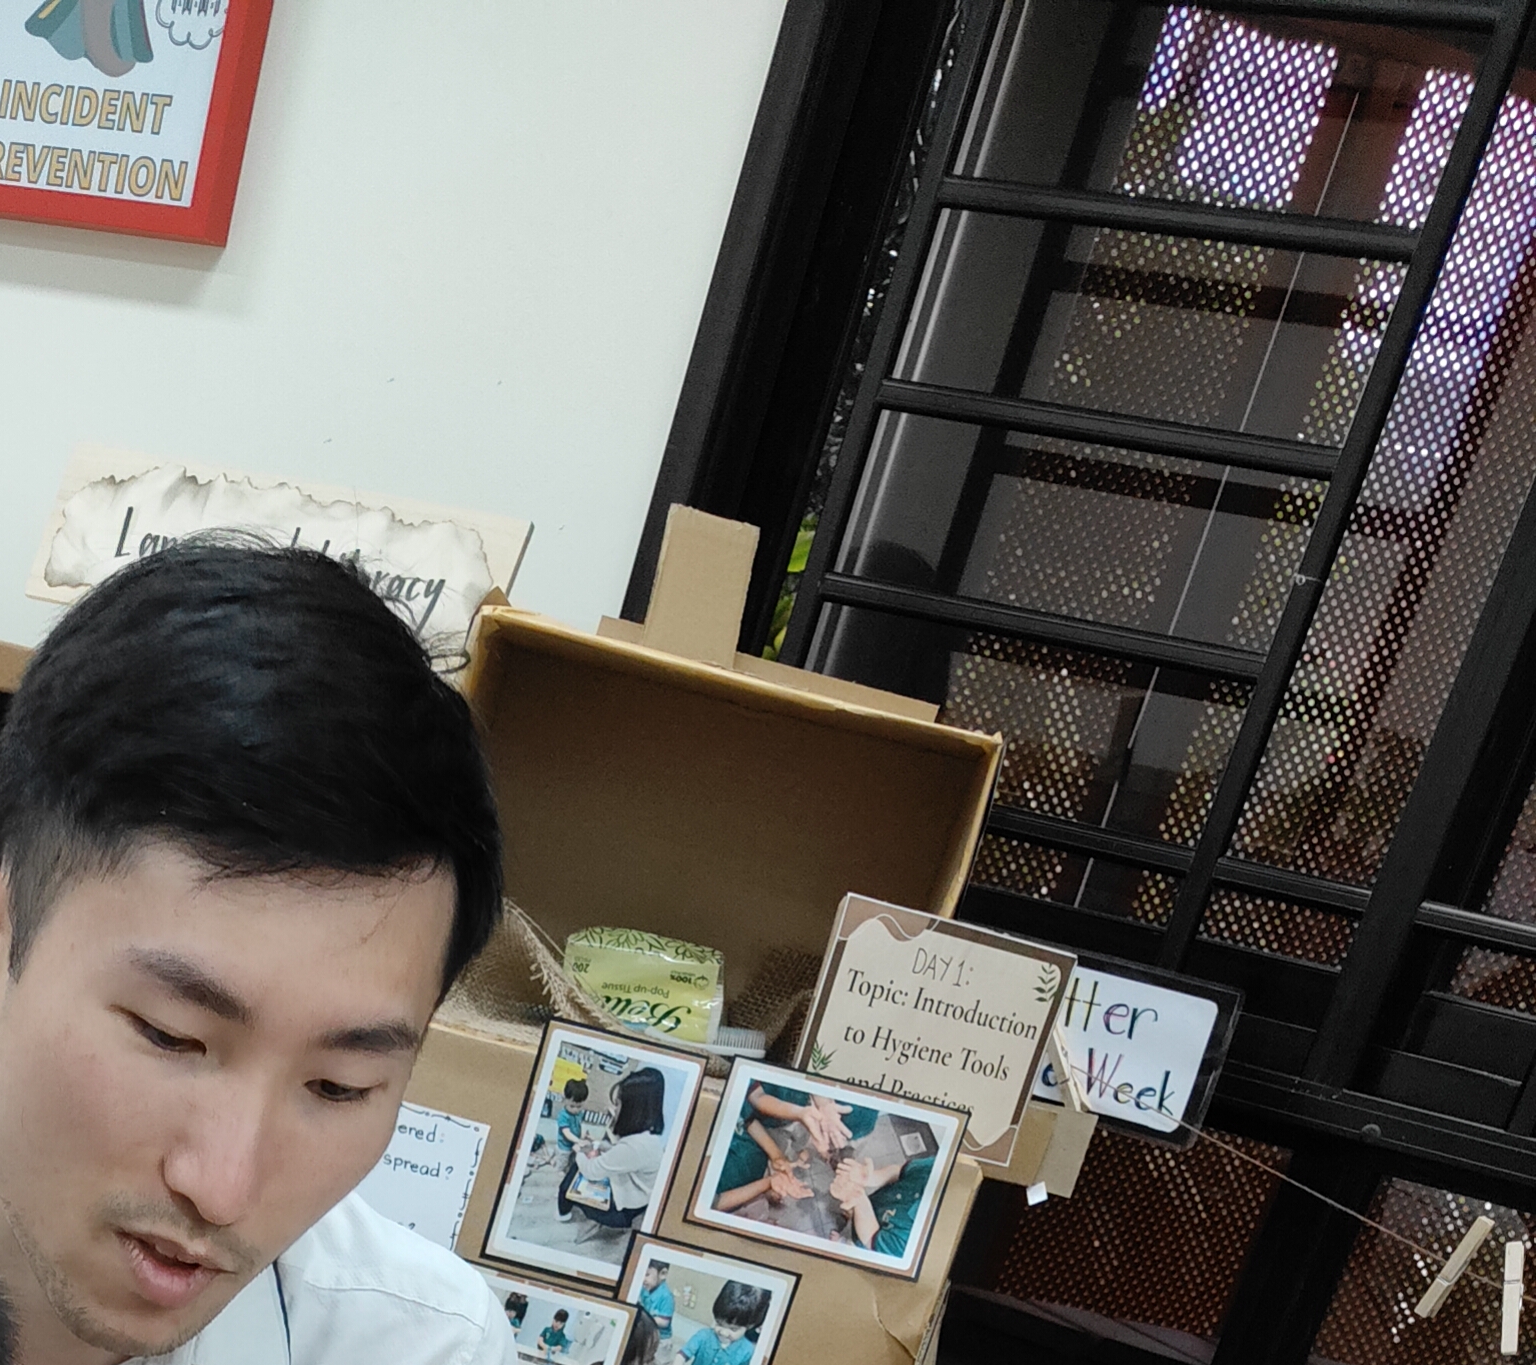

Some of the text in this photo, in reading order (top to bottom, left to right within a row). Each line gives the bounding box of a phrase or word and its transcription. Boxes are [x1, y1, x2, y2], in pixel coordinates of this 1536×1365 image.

[601, 981, 670, 999] Pop-up Tissue
[912, 947, 955, 986] DAY
[847, 967, 1039, 1041] Topic: Introduction
[843, 1024, 865, 1045] to
[871, 1026, 953, 1067] Hygiene
[960, 1048, 1010, 1082] Tools
[1087, 1047, 1175, 1116] Week
[398, 1123, 445, 1143] ered:
